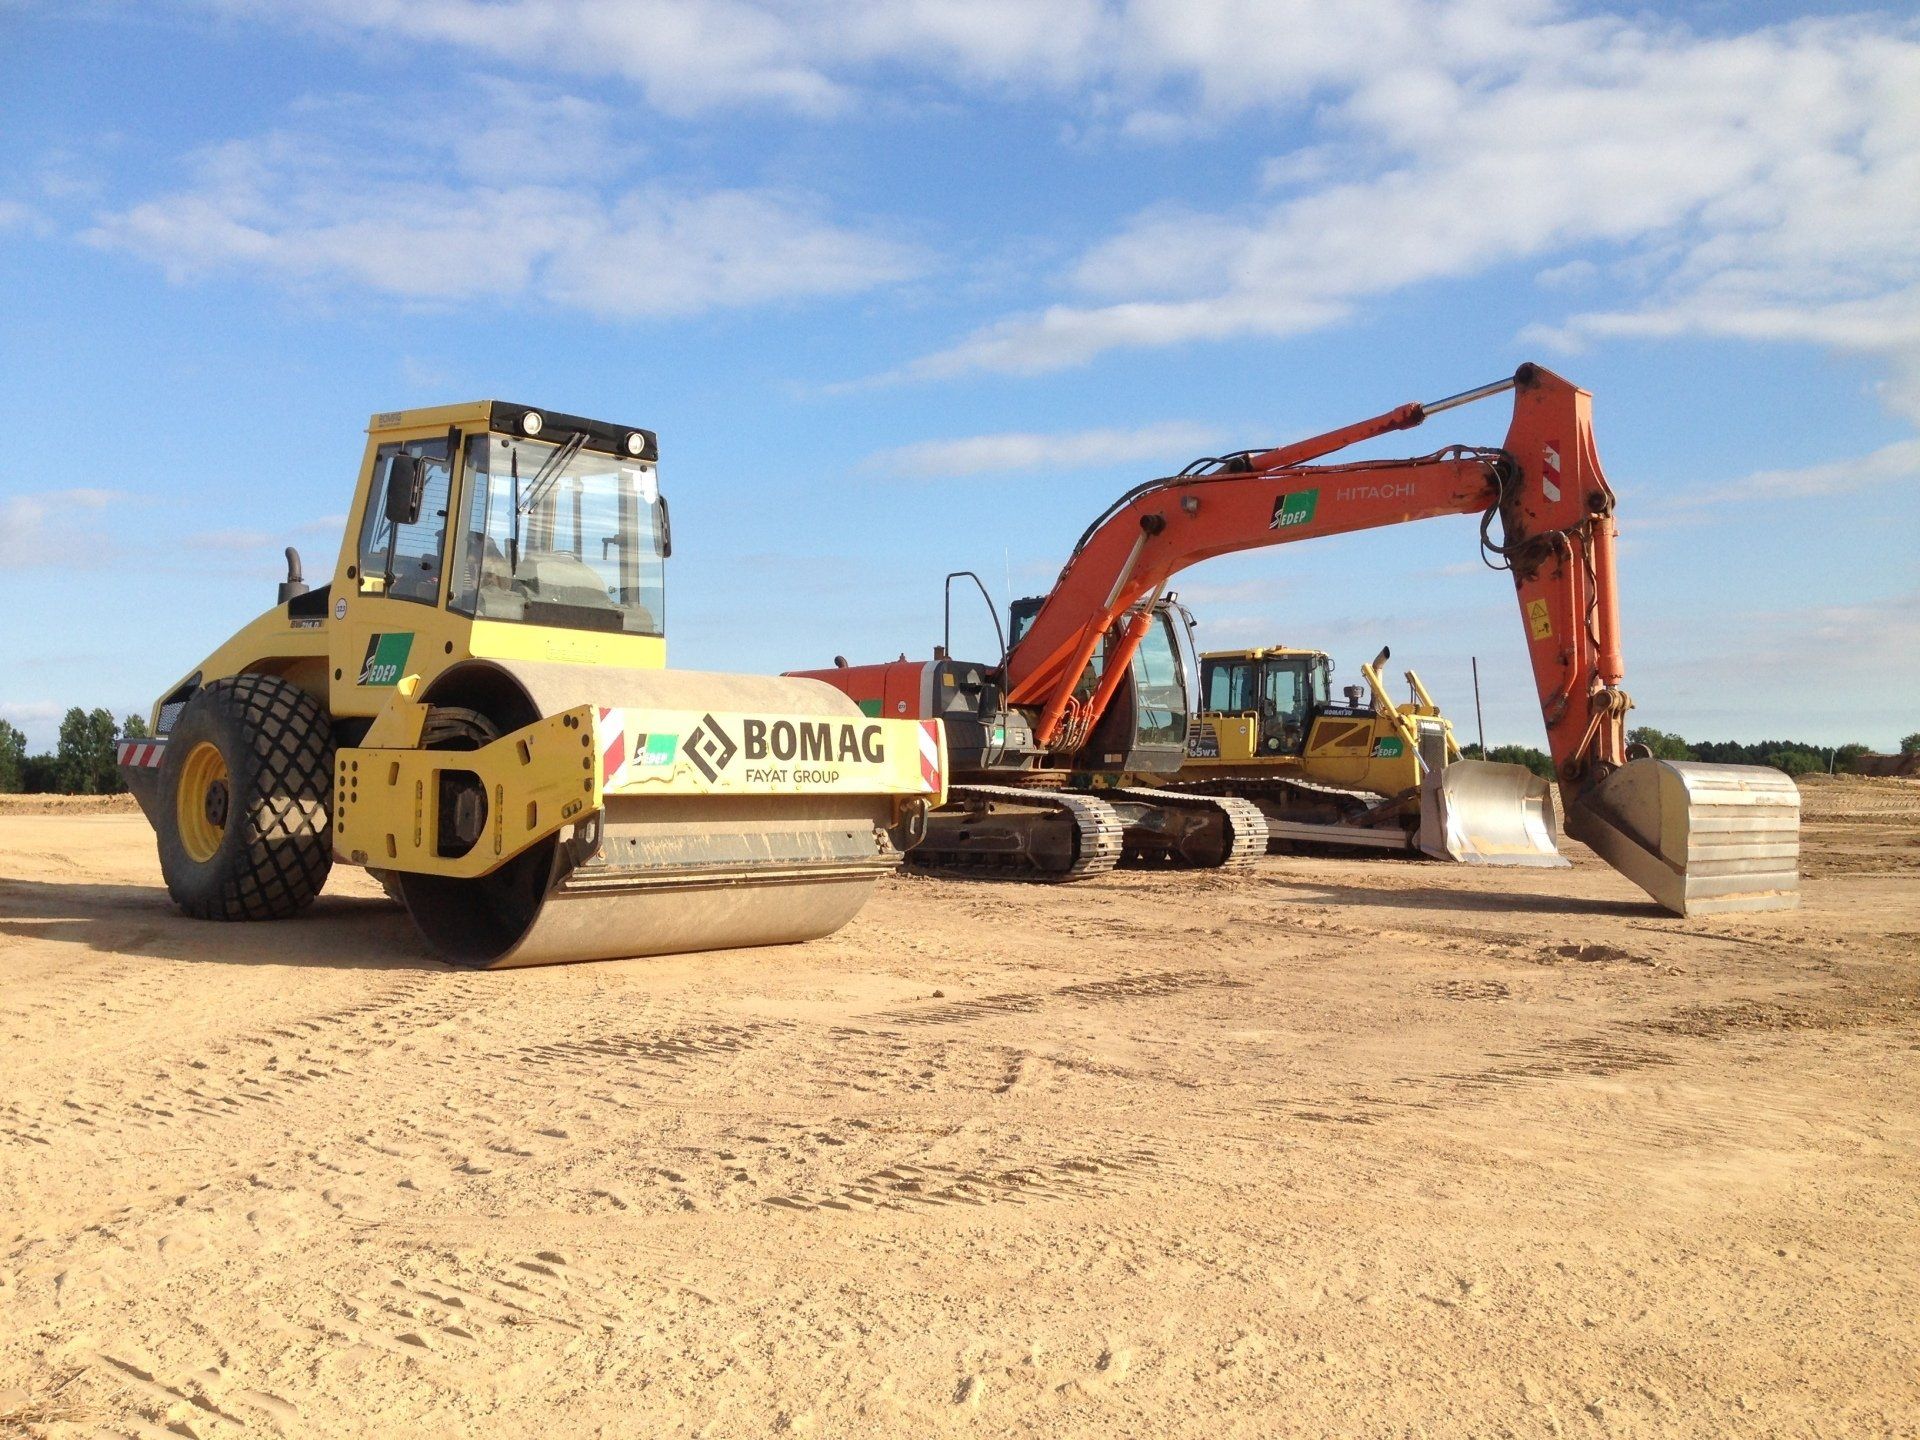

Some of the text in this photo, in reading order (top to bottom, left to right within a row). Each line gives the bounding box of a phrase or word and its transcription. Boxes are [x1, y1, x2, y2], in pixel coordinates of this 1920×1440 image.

[1337, 483, 1415, 500] HITACHI
[1269, 509, 1307, 529] SEDEP
[357, 655, 397, 684] SEDEP
[743, 718, 885, 764] BOMAG
[1370, 744, 1398, 757] SEDEP
[745, 768, 840, 784] FAYAT GROUP
